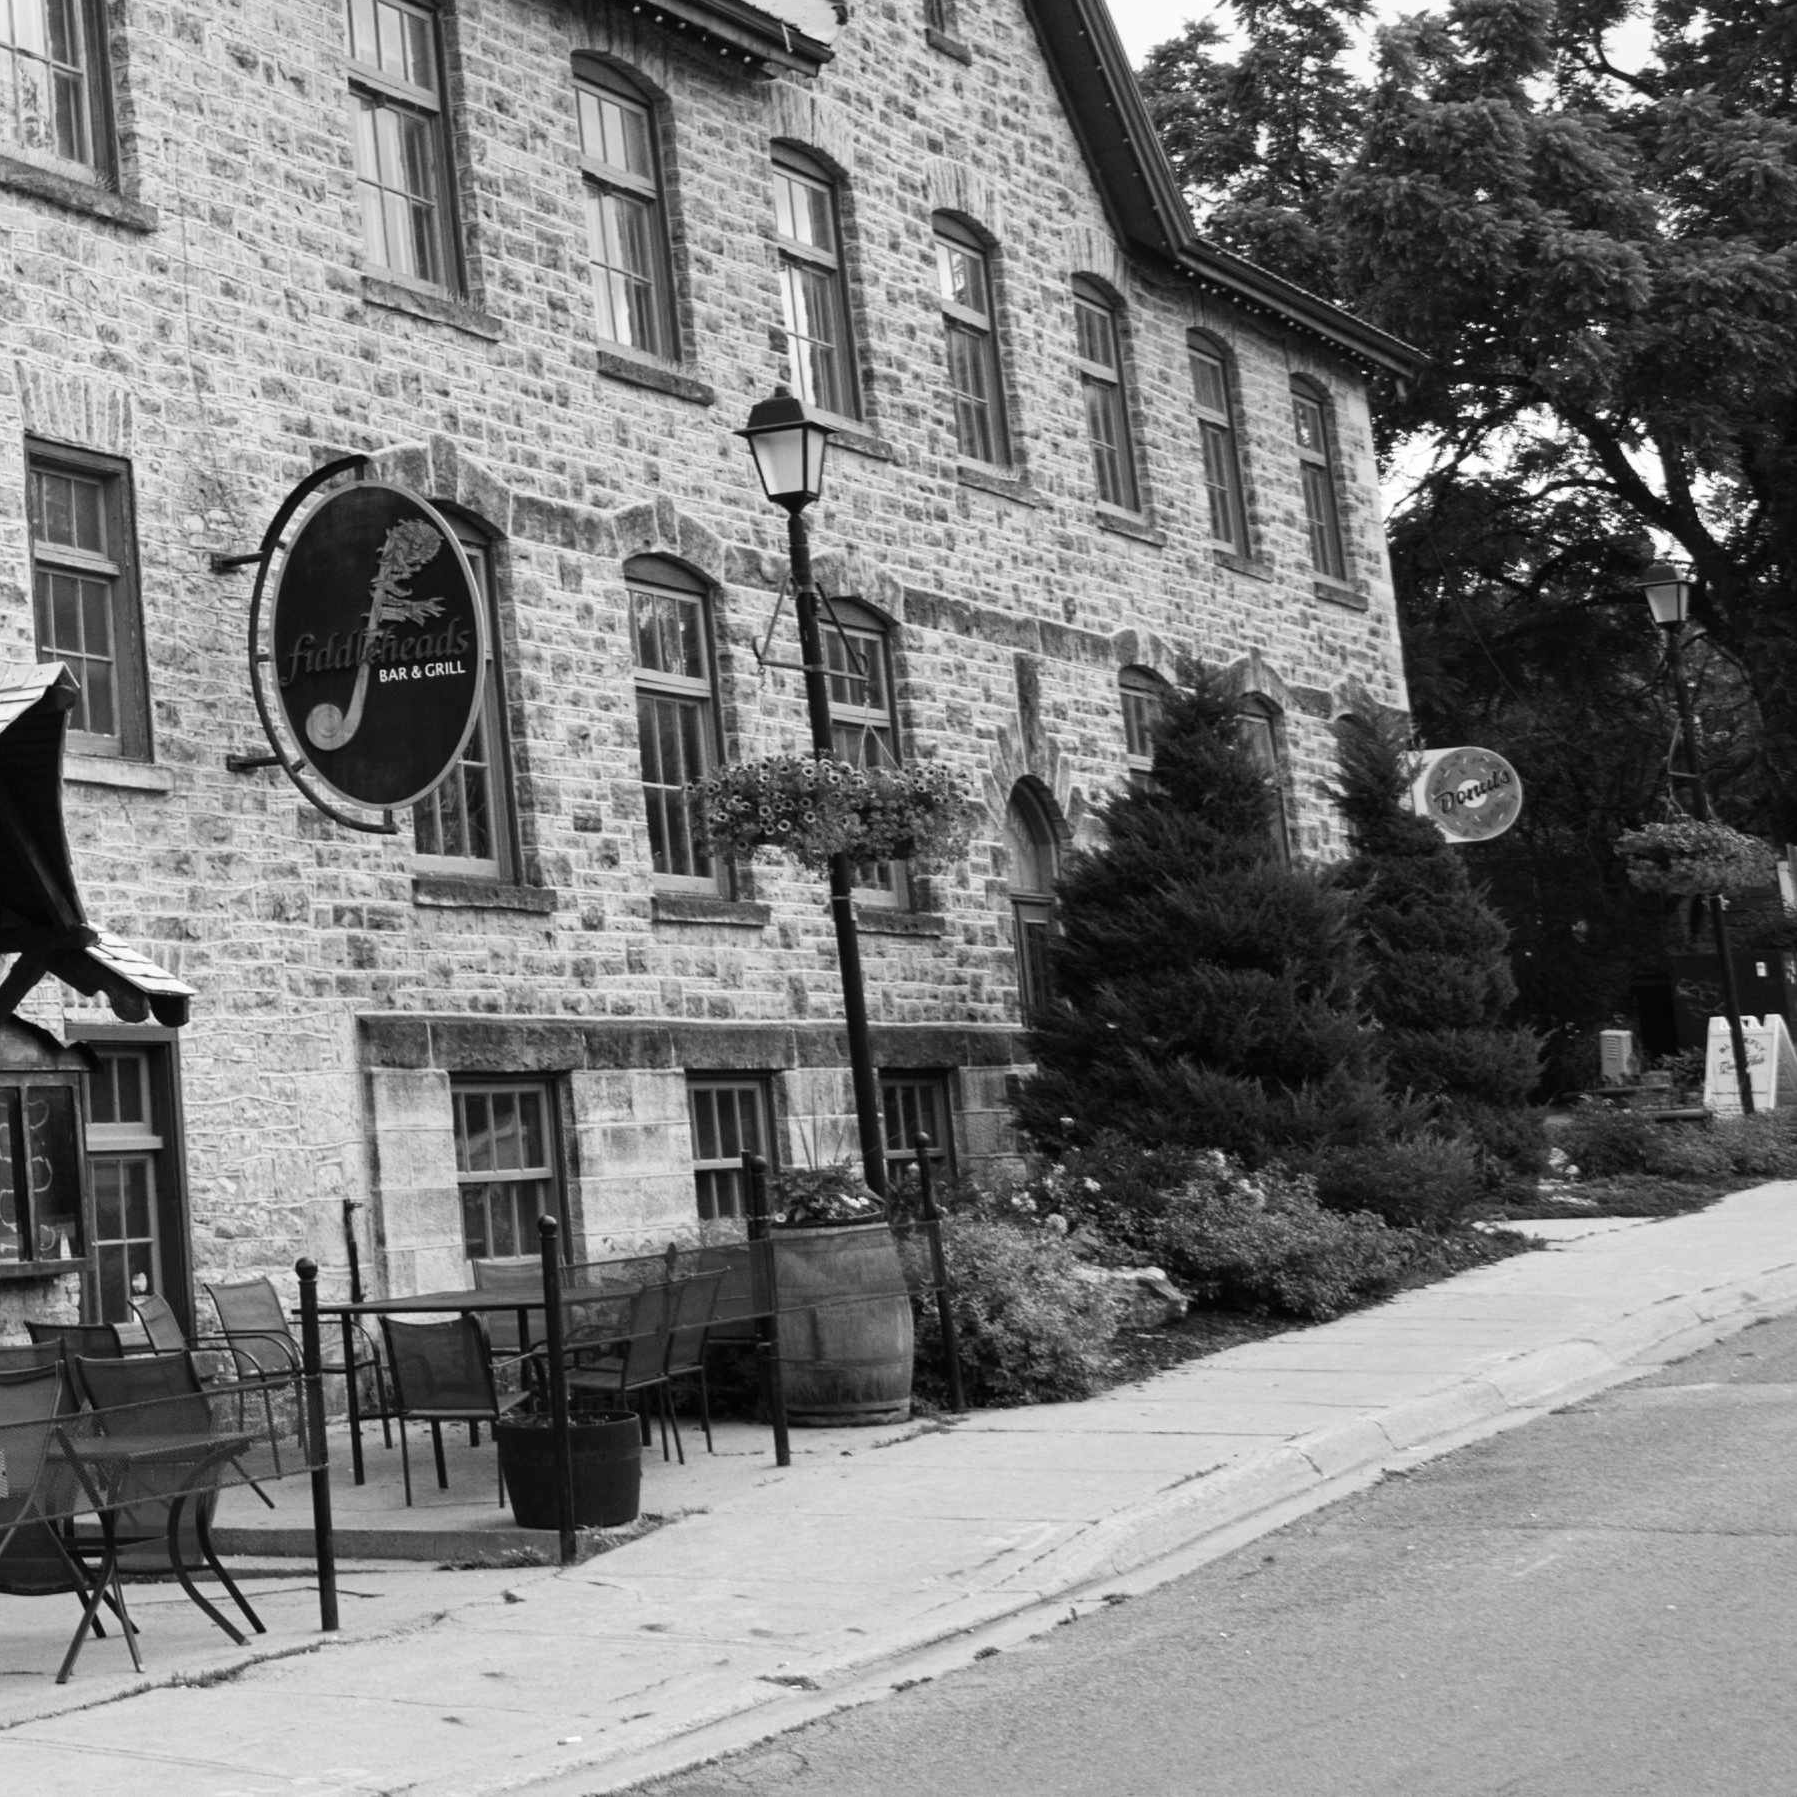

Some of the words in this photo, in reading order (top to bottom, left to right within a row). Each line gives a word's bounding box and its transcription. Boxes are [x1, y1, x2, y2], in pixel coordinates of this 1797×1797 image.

[278, 617, 470, 687] fiddleheads
[378, 667, 408, 683] BAR
[411, 665, 422, 680] &
[424, 661, 466, 678] GRILL
[1433, 769, 1511, 814] Donuts
